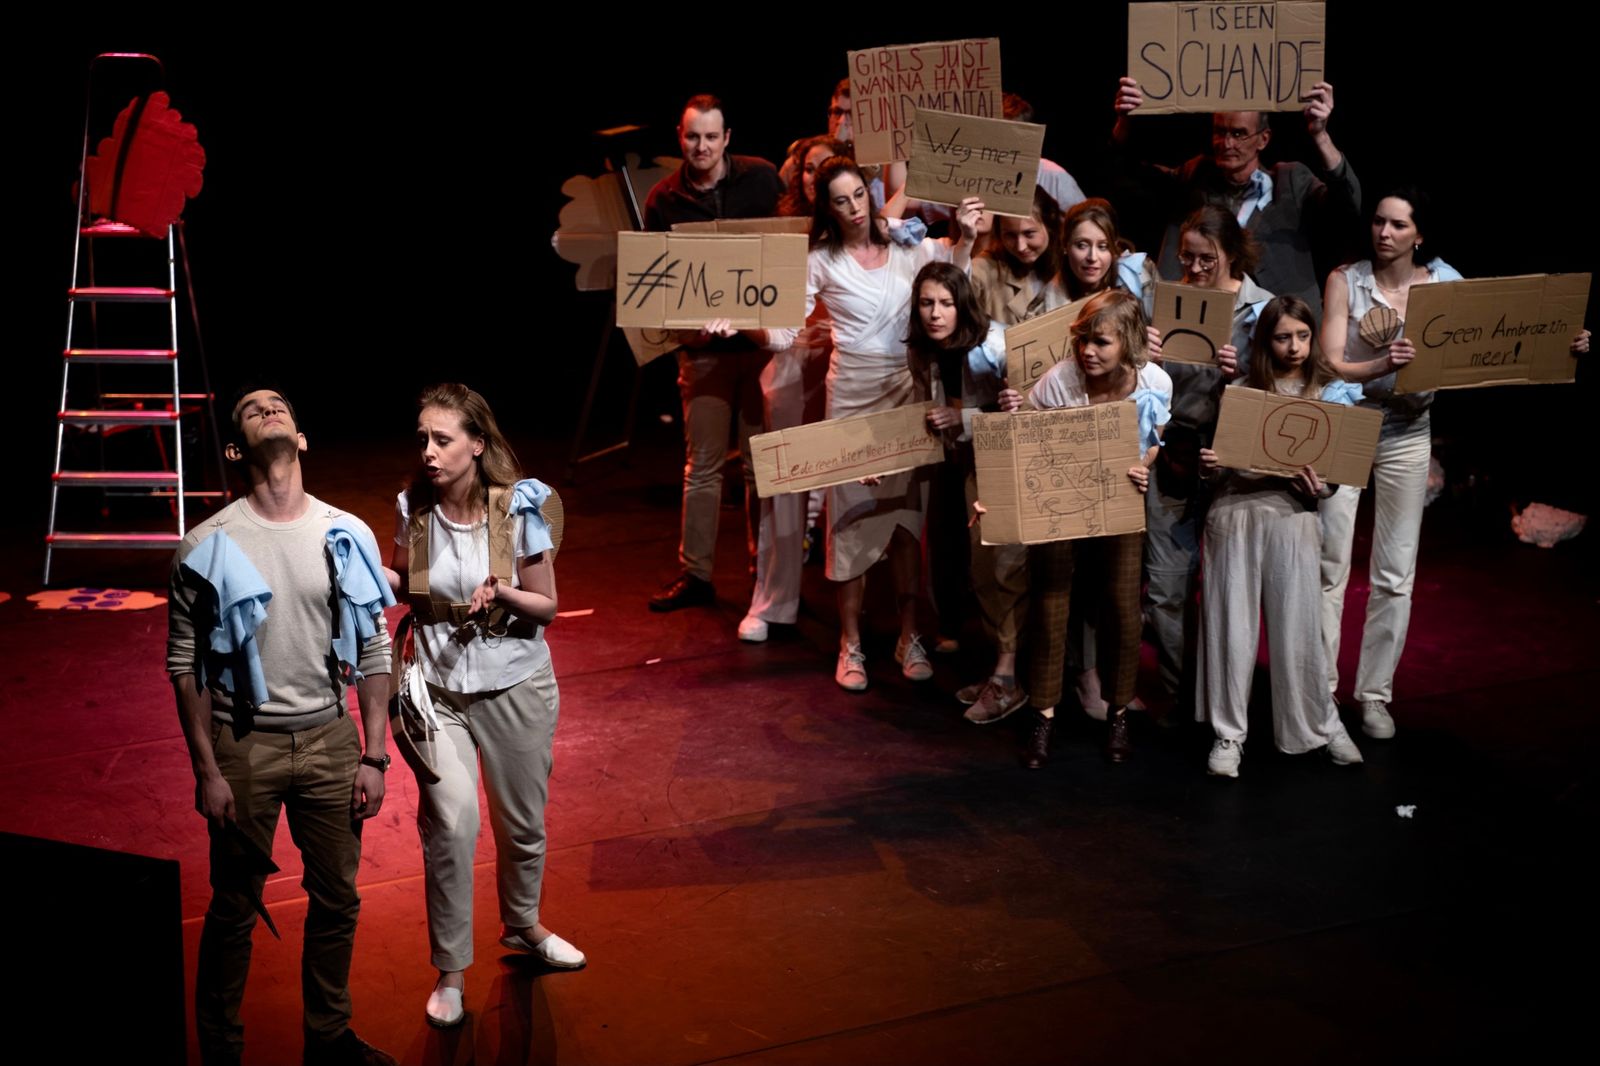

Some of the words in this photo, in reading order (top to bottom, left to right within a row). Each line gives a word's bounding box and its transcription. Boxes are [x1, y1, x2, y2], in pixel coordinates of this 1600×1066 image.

[1210, 6, 1228, 31] IS
[1234, 5, 1275, 30] EEN
[855, 47, 924, 77] GIRLS
[935, 41, 990, 69] JUST
[1140, 40, 1323, 104] SCHANDE
[853, 72, 925, 96] WANNA
[934, 67, 992, 91] HAVE
[924, 122, 973, 163] Weg
[1421, 313, 1483, 349] Geen
[1011, 339, 1044, 382] Te
[1470, 341, 1522, 367] meer!
